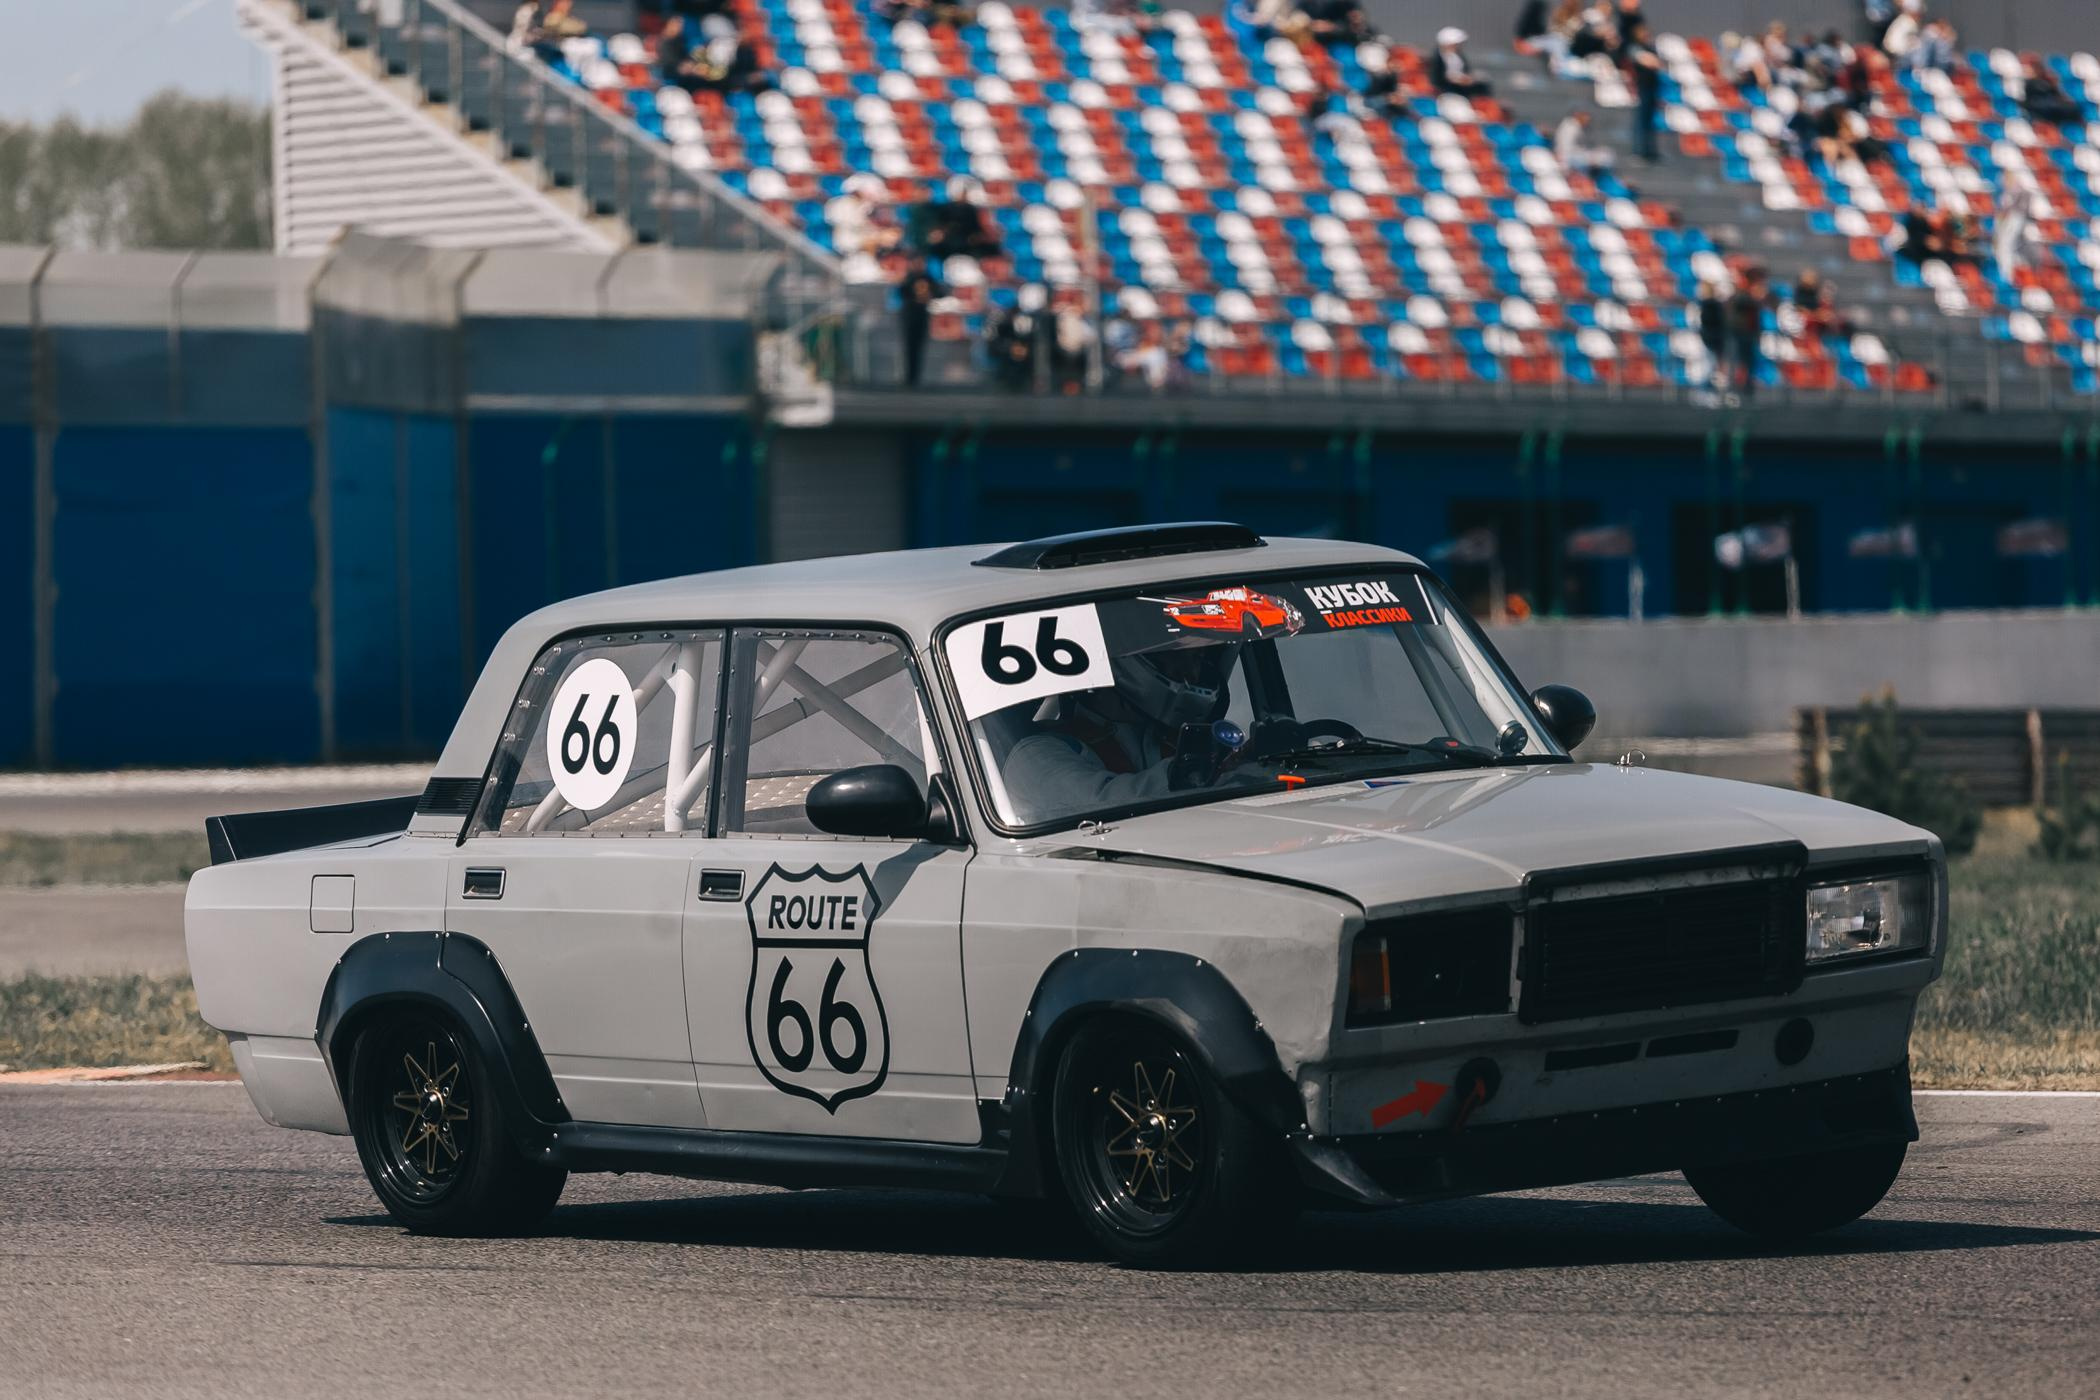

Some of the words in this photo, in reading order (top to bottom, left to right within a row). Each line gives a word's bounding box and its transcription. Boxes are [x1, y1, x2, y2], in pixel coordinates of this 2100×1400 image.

[1303, 580, 1400, 610] КУБОК
[1323, 606, 1413, 629] КЛАССИКИ
[981, 616, 1090, 685] 66
[561, 693, 621, 775] 66
[768, 894, 858, 931] ROUTE
[766, 955, 868, 1075] 66
